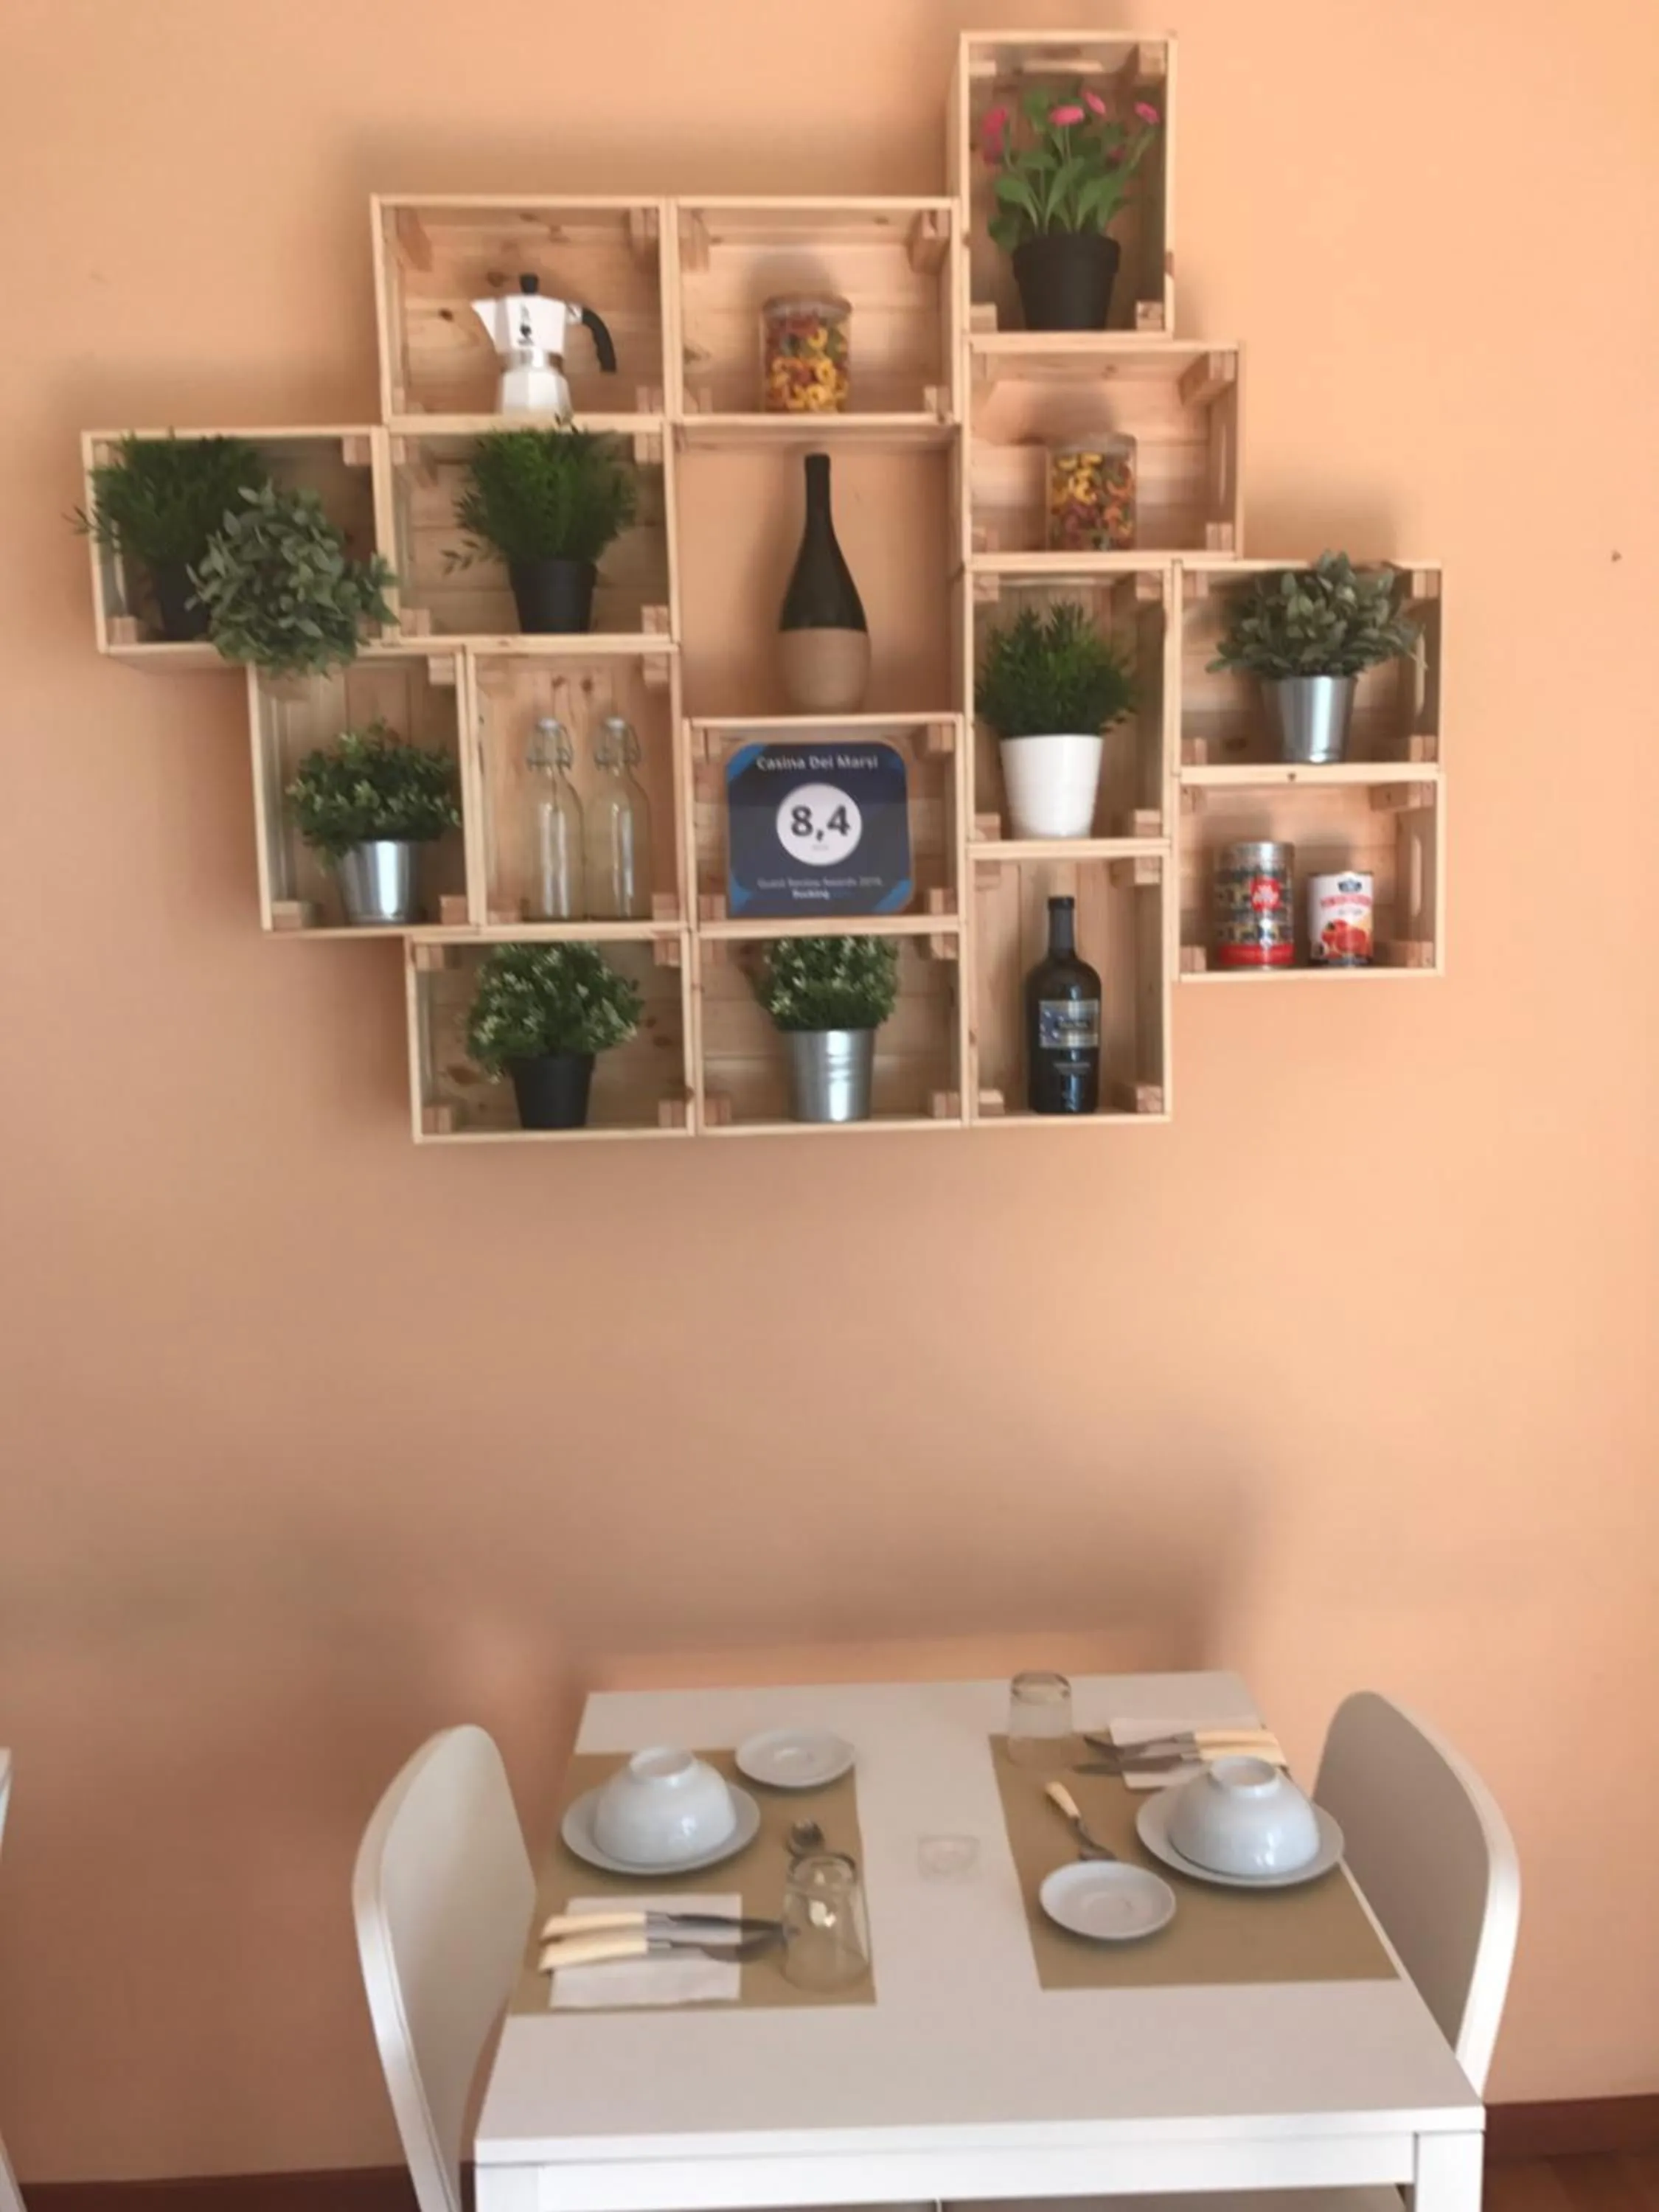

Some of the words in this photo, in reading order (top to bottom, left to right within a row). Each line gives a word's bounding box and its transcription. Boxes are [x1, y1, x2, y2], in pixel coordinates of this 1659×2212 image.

[756, 755, 805, 771] Casina
[809, 755, 834, 770] Dei
[790, 804, 851, 841] 8,4
